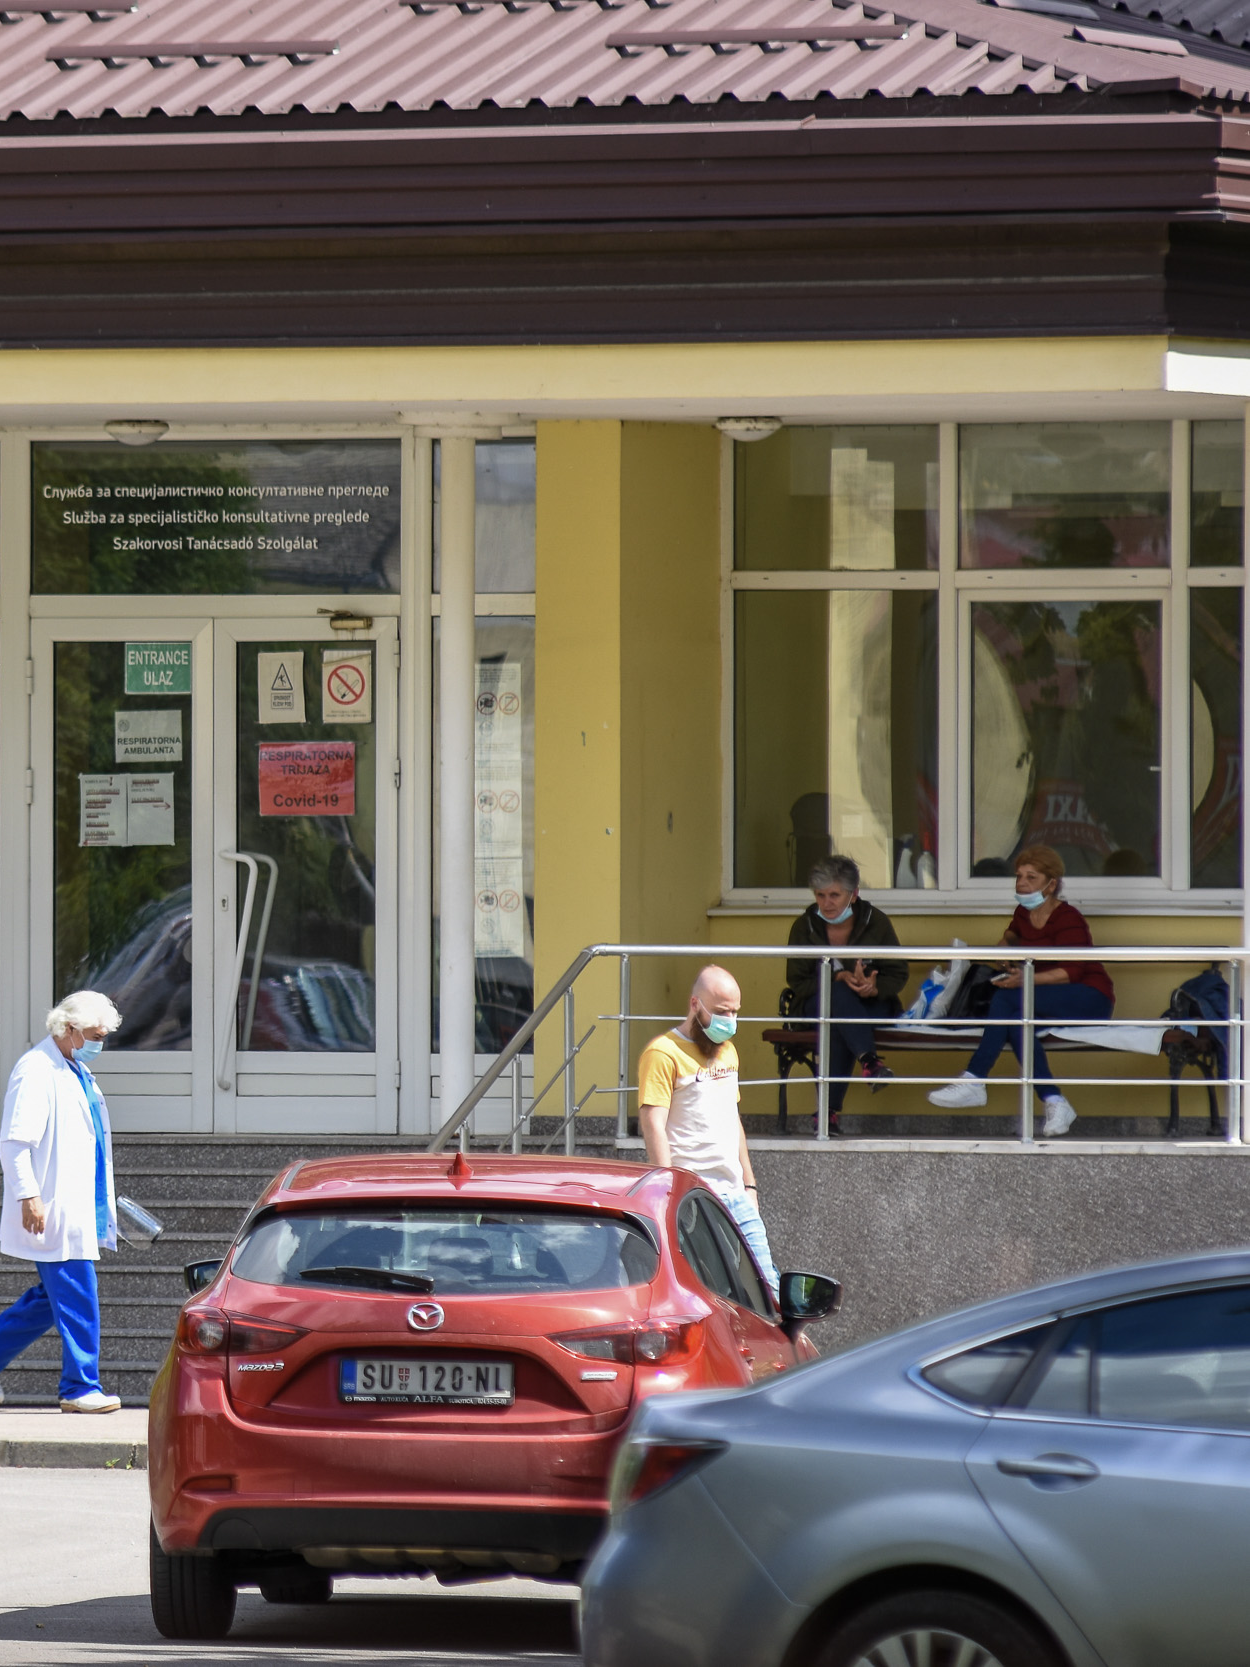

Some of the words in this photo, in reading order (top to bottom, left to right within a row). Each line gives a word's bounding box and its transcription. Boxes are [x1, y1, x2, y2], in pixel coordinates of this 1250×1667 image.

[42, 484, 93, 501] Служба
[96, 486, 111, 498] за
[114, 484, 224, 500] специјалистичко
[228, 485, 324, 499] консултативне
[327, 485, 390, 499] прегледе
[62, 509, 106, 524] Služba
[109, 512, 125, 524] za
[128, 509, 219, 527] specijalističko
[222, 509, 310, 523] konsultativne
[313, 509, 370, 526] preglede
[113, 536, 183, 550] Szakorvosi
[186, 535, 254, 550] Tanácsadó
[257, 535, 318, 552] Szolgálat
[128, 650, 189, 665] ENTRANCE
[143, 671, 174, 686] ULAZ
[117, 736, 181, 746] RESPIRATORNA
[123, 746, 175, 755] AMBULANTA
[259, 750, 353, 761] RESPIRATORNA
[280, 763, 331, 775] TRIJAŽA
[273, 793, 339, 807] Covid-19
[362, 1363, 394, 1391] SU
[413, 1395, 445, 1403] ALFA
